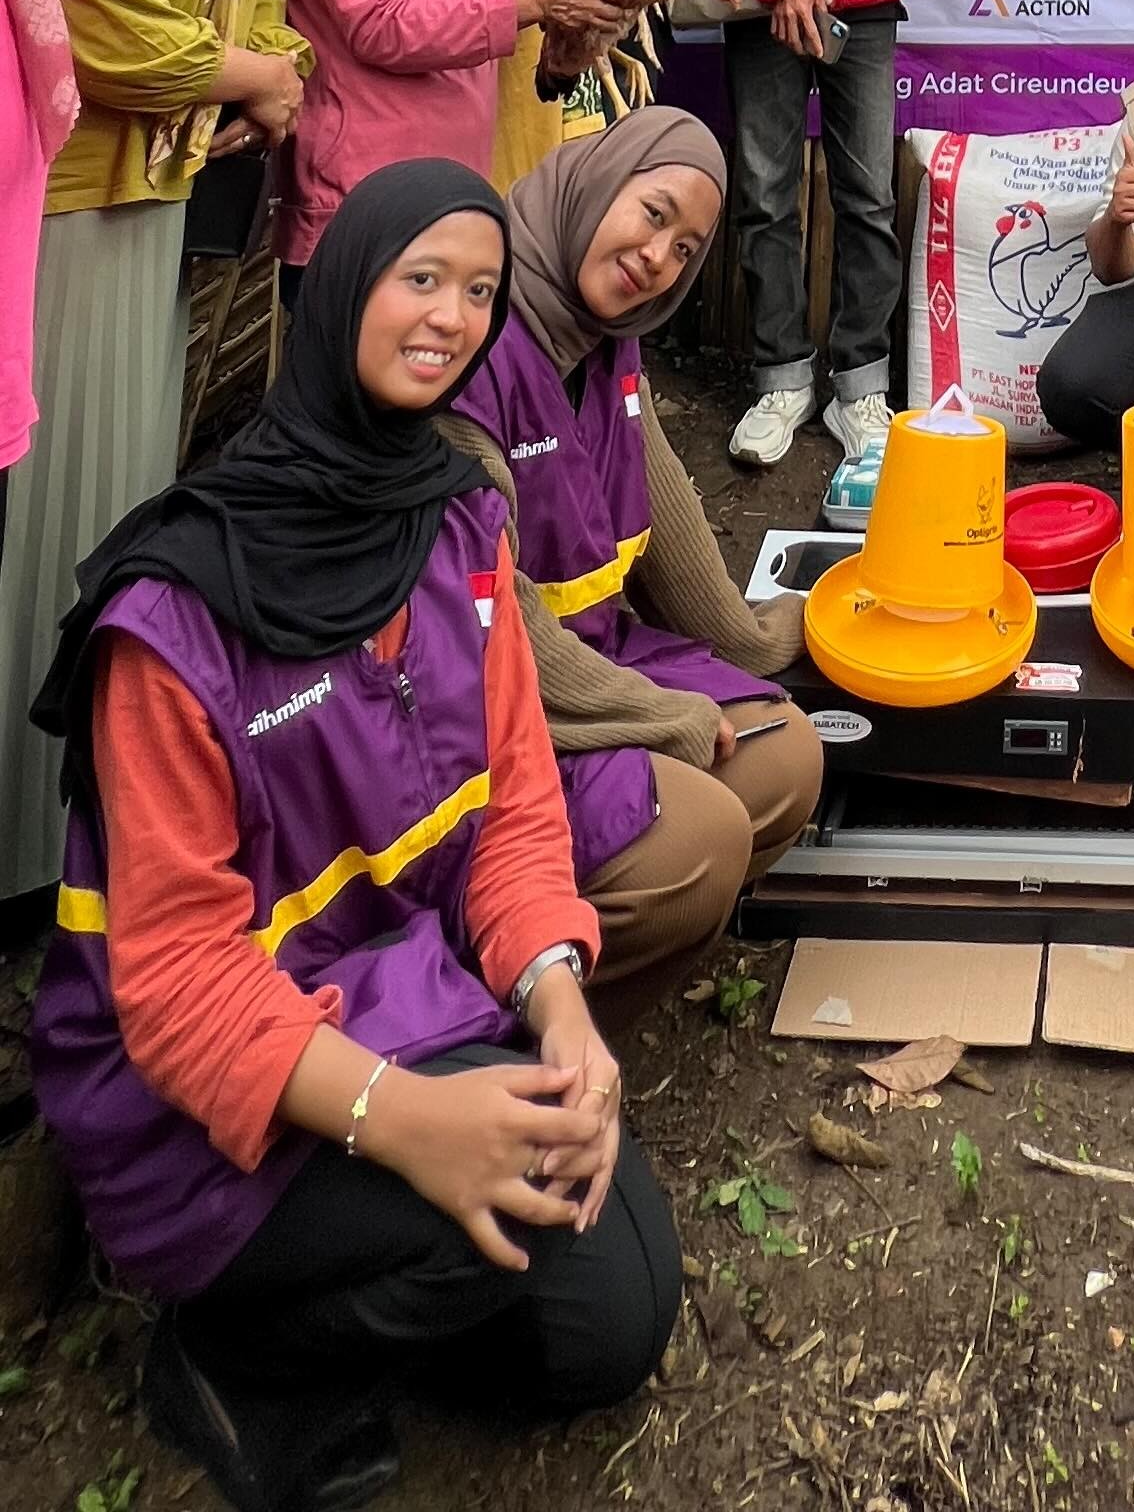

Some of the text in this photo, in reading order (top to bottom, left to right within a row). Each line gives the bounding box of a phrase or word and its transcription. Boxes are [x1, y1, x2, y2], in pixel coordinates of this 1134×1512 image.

[1015, 0, 1090, 17] ACTION
[919, 72, 983, 95] Adat
[991, 73, 1126, 95] Cireundeu
[1054, 136, 1081, 151] P3
[990, 148, 1028, 166] Pakan
[1032, 155, 1067, 168] Ayam
[989, 372, 1011, 387] EAST
[1015, 380, 1035, 390] HOP
[969, 392, 1013, 412] KAWASAN
[1008, 390, 1038, 402] SURYA
[247, 672, 332, 737] aihmimpi
